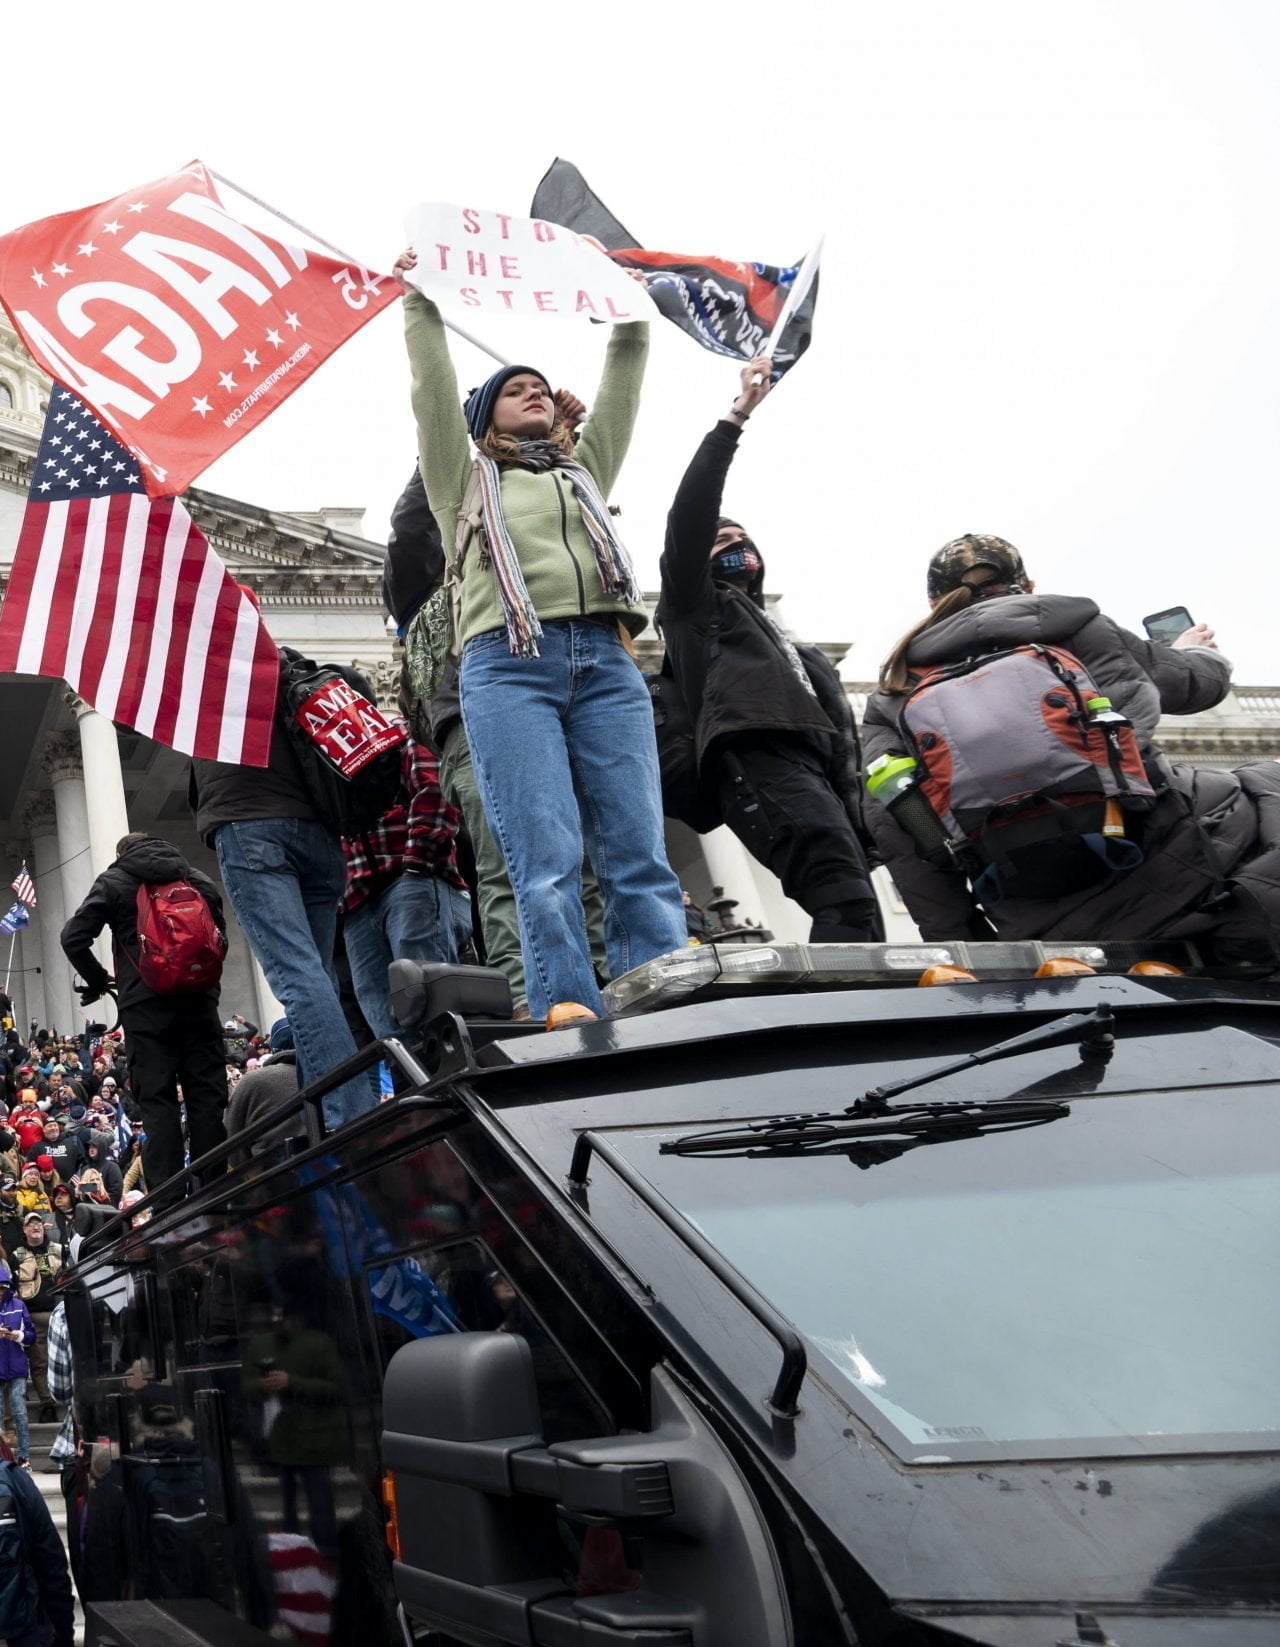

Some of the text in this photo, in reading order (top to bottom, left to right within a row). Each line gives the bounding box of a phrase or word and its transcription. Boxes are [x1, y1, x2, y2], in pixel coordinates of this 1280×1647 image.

[435, 243, 522, 279] THE
[459, 287, 631, 318] STEAL
[304, 683, 363, 736] AME
